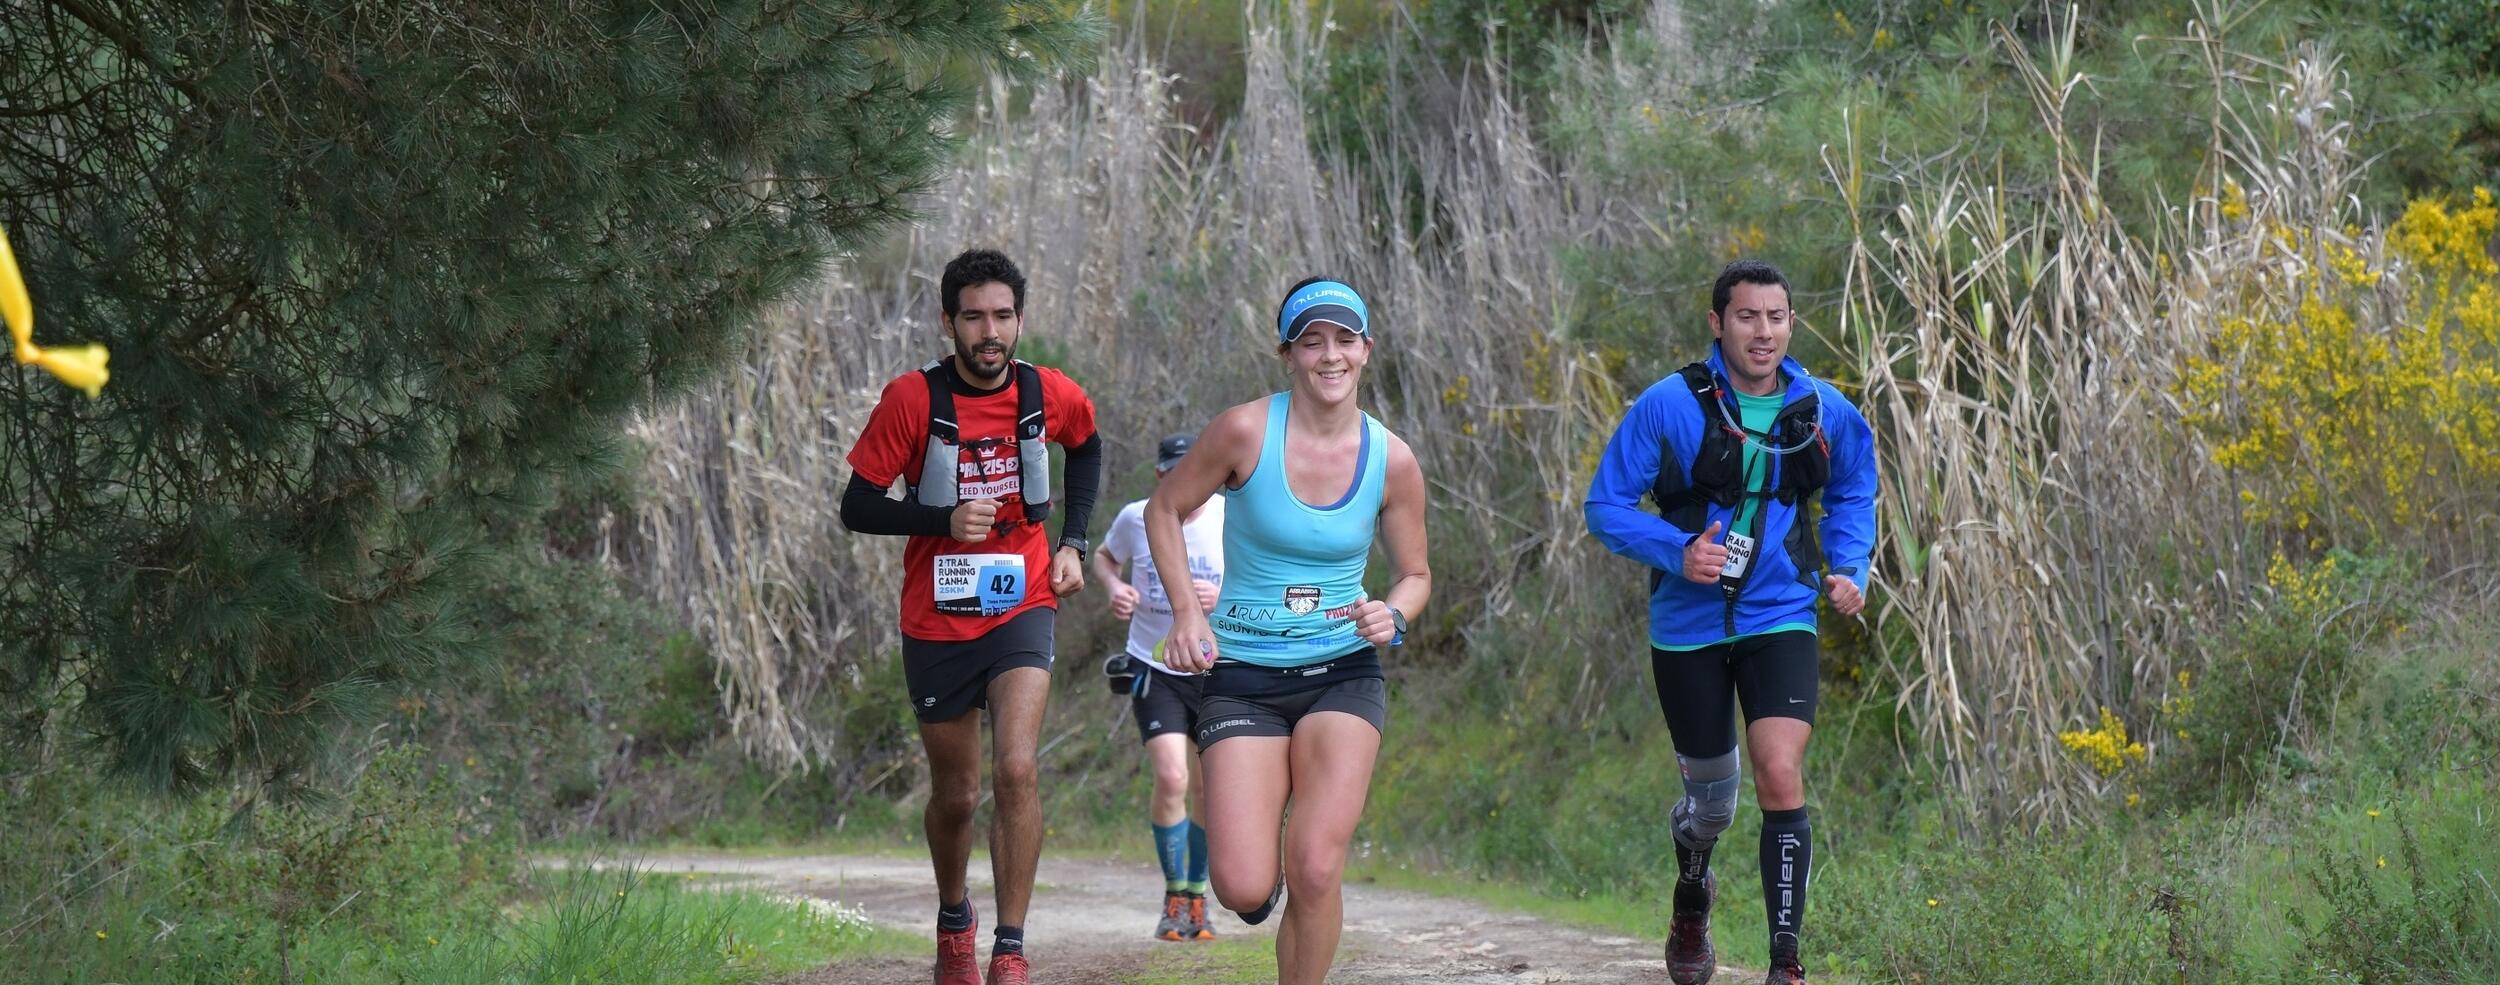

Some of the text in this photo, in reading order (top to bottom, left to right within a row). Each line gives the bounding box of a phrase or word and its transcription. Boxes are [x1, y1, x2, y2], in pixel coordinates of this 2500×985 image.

[959, 480, 1018, 496] CEED YOURSEL
[1727, 535, 1747, 549] RAIL
[946, 558, 970, 567] TRAIL
[938, 567, 976, 577] RUNNING
[938, 577, 969, 586] CANHA
[990, 574, 1015, 595] 42
[1210, 719, 1255, 733] LURBEL
